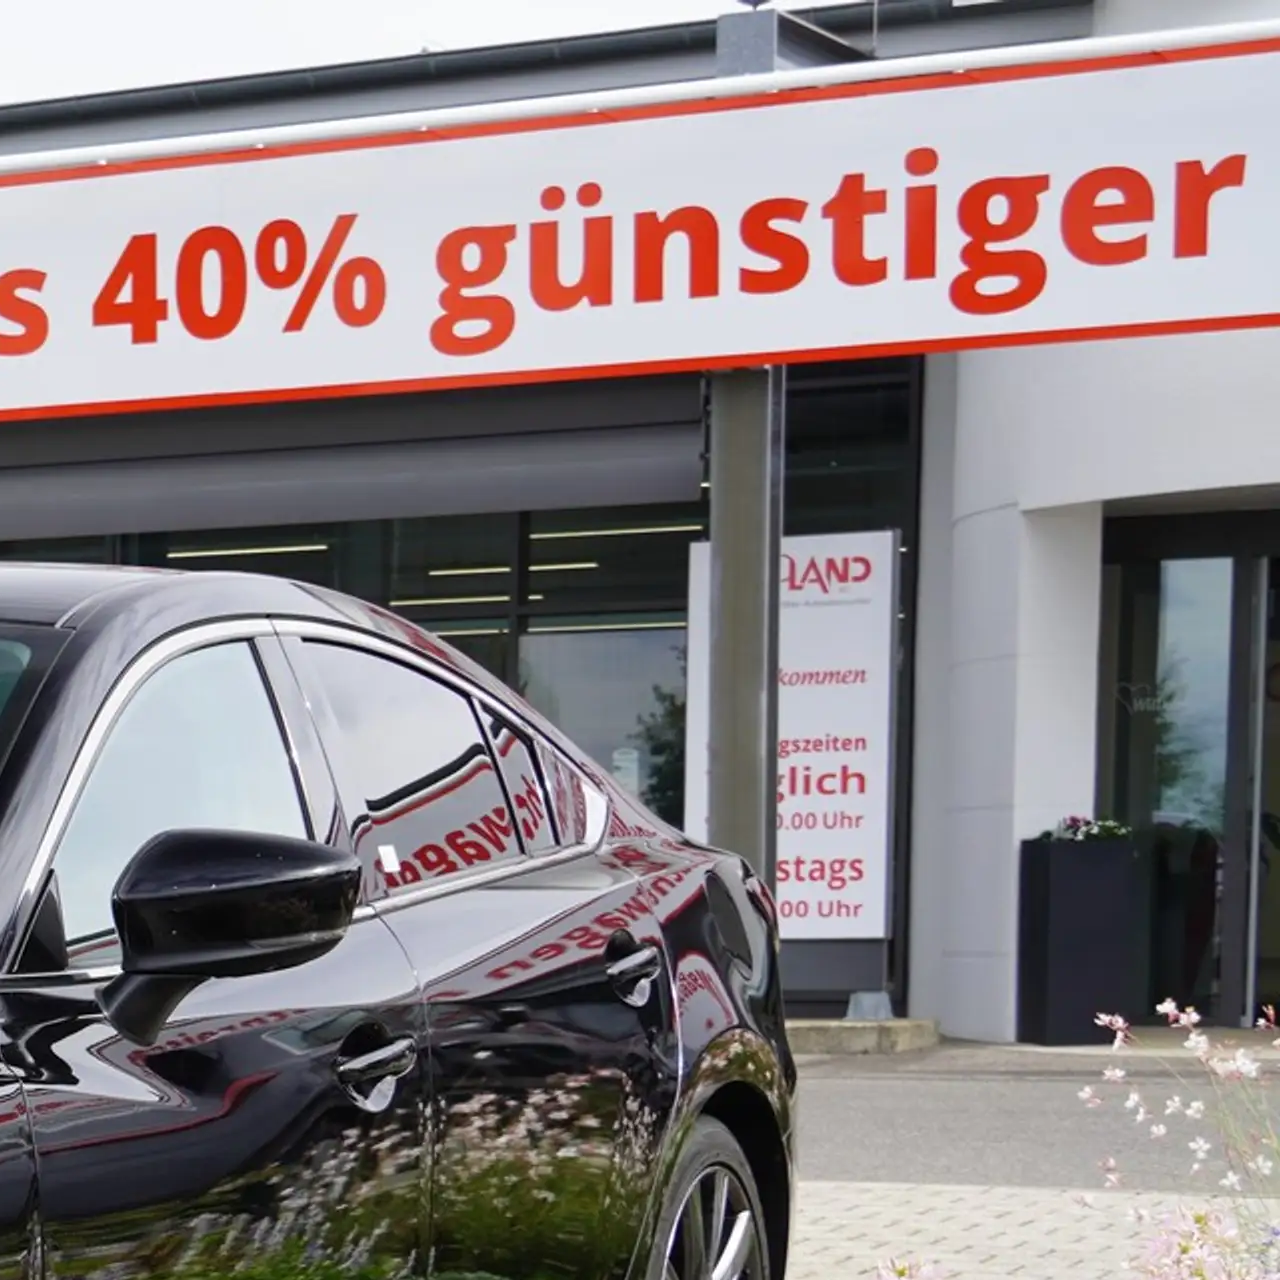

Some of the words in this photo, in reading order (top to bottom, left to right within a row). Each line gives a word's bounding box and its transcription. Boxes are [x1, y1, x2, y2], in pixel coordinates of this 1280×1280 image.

[92, 214, 386, 345] 40%
[430, 147, 1247, 356] günstiger
[778, 668, 867, 687] kommen
[778, 733, 867, 759] gszeiten
[822, 811, 864, 830] Uhr
[776, 856, 864, 891] stags
[817, 900, 863, 918] Uhr
